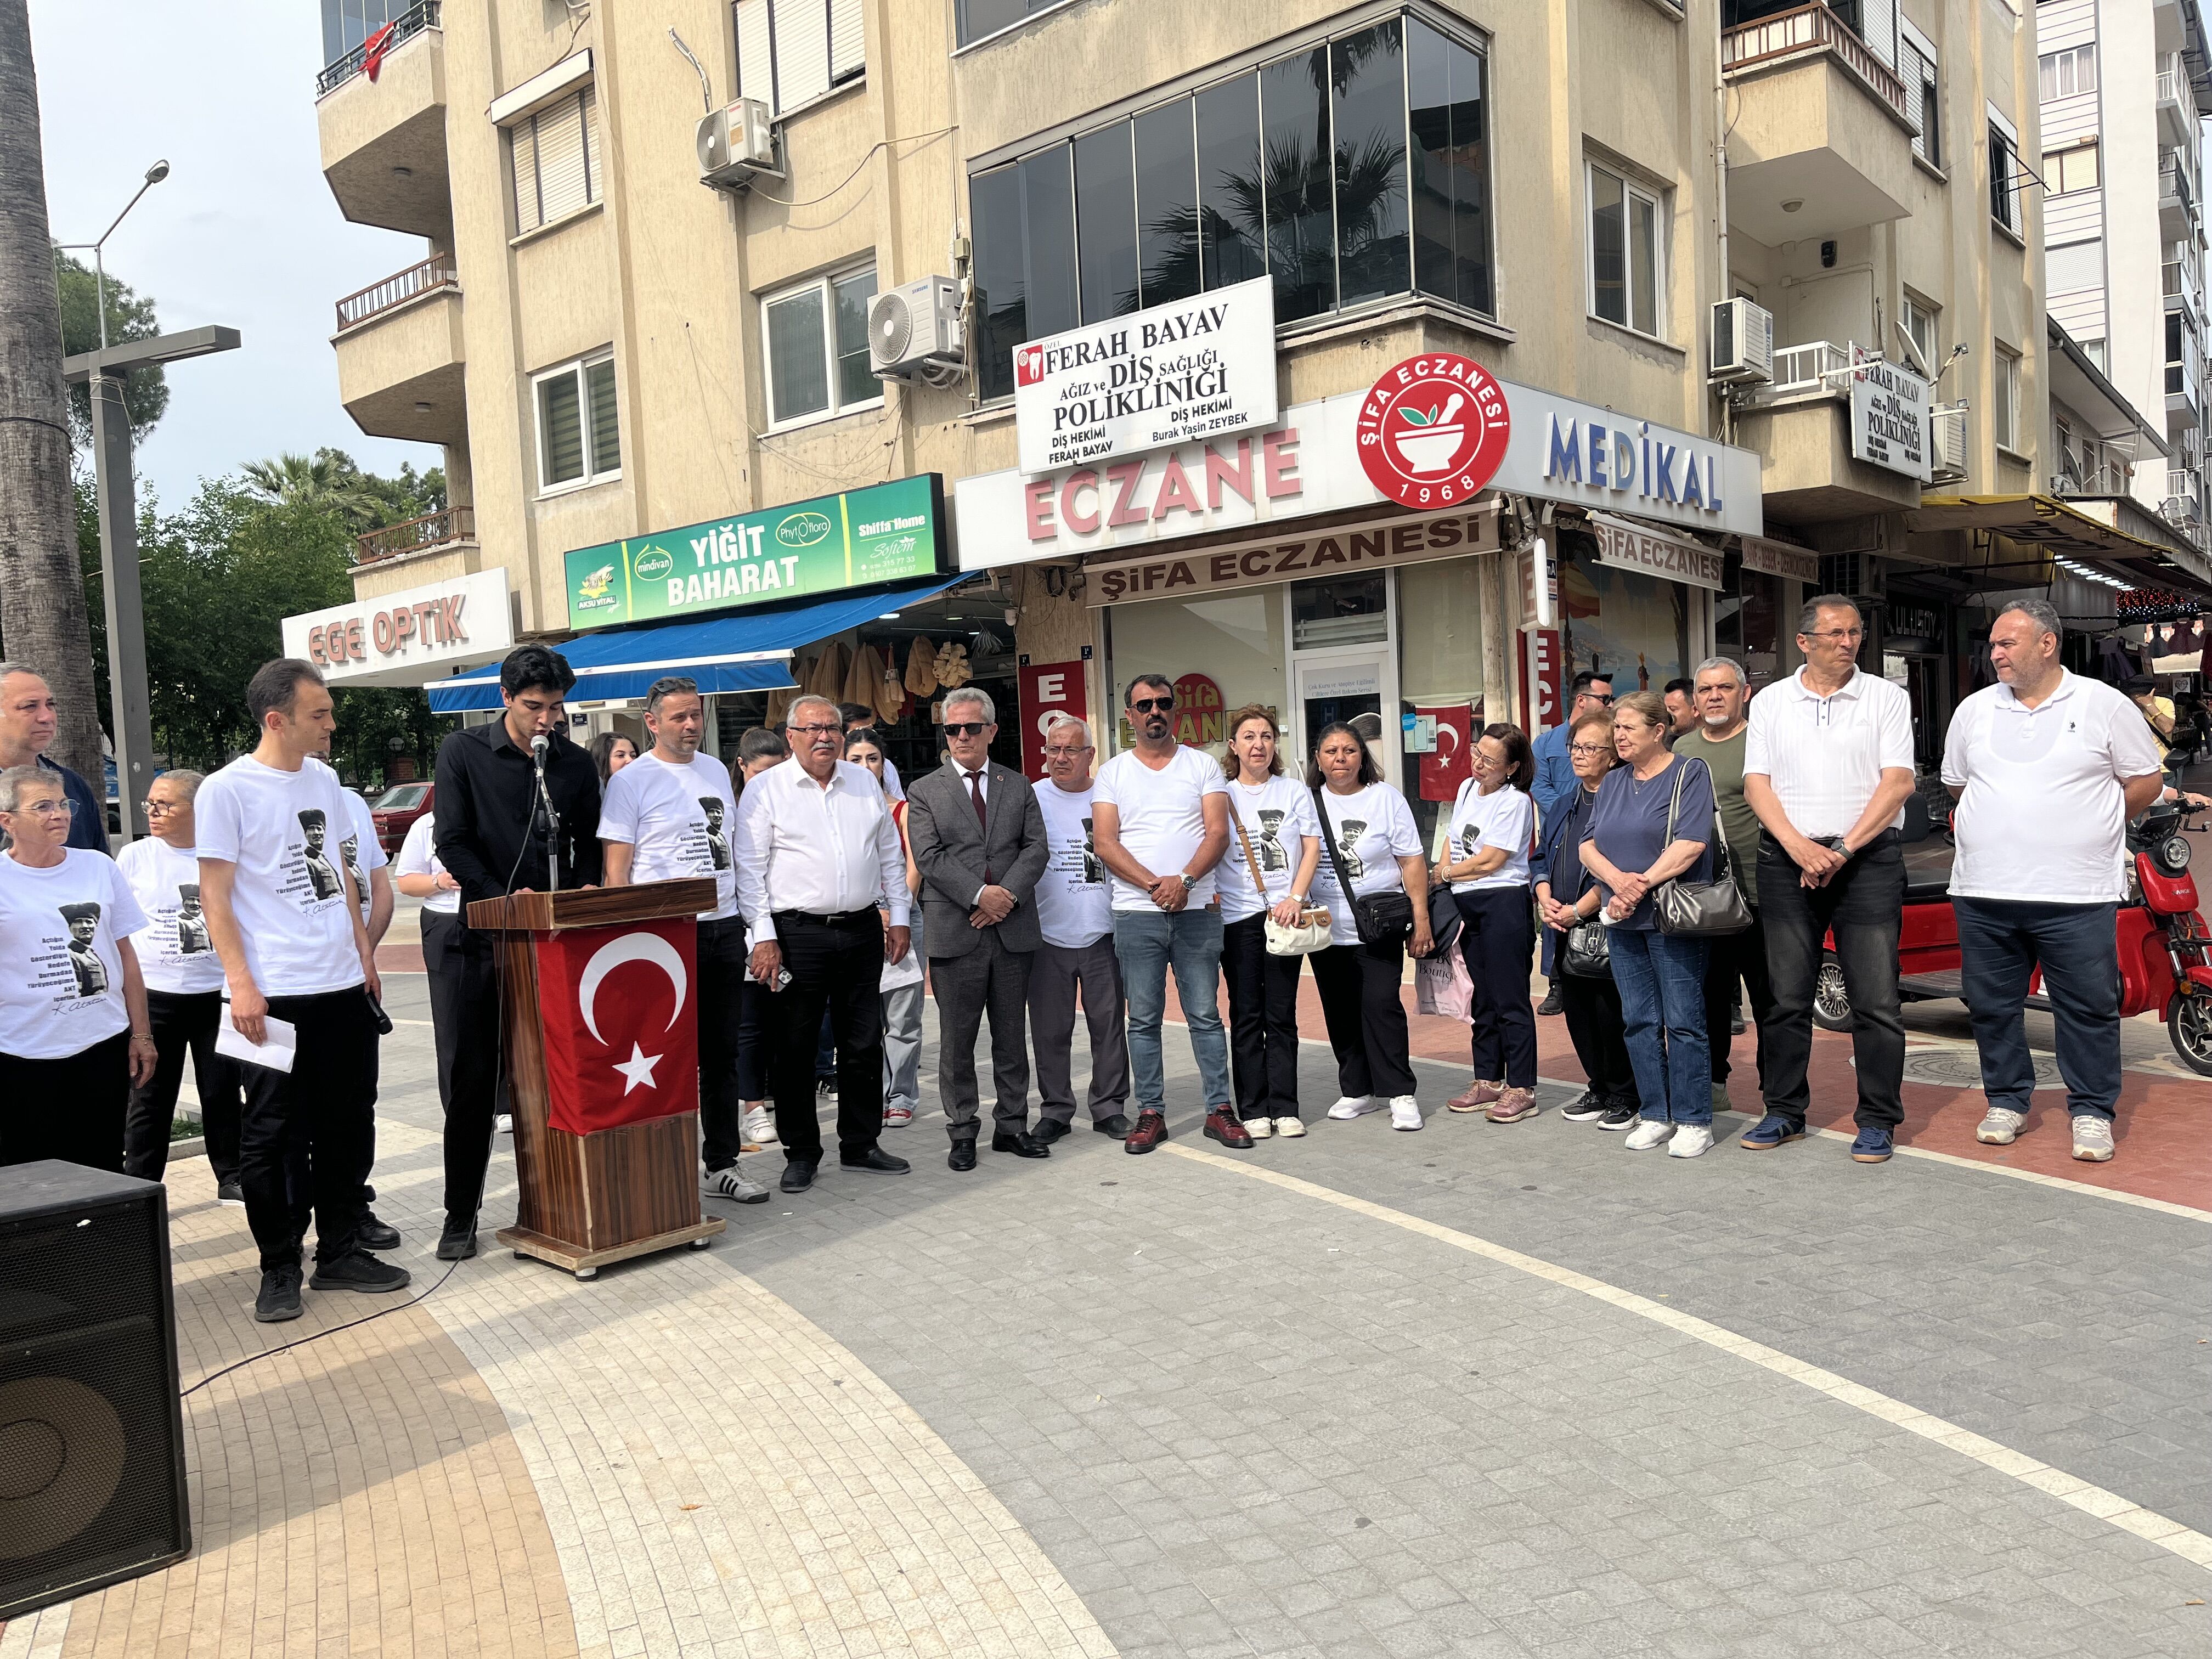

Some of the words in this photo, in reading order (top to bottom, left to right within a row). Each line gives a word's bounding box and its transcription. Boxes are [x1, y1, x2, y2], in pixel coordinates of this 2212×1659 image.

[1045, 330, 1130, 375] FERAH
[1140, 303, 1229, 349] BAYAV
[1045, 341, 1062, 350] ÖZEL
[1060, 382, 1091, 401] AĞIZ
[1094, 381, 1106, 391] ve
[1109, 353, 1153, 388] DİŞ
[1159, 348, 1218, 376] SAĞLIĞI
[1895, 375, 1920, 403] BAYAV
[1053, 362, 1228, 431] POLİKLİNİĞİ
[1171, 407, 1189, 422] DİŞ
[1192, 396, 1233, 418] HEKİMİ
[1359, 388, 1391, 445] ŞİFA
[1396, 359, 1508, 428] ECZANESİ
[1887, 393, 1900, 423] DİŞ
[1052, 435, 1068, 449] DİŞ
[1070, 424, 1107, 444] HEKİMİ
[1153, 430, 1179, 442] Burak
[1181, 421, 1206, 436] Yasin
[1209, 412, 1248, 430] ZEYBEK
[1049, 448, 1079, 465] FERAH
[1083, 441, 1113, 458] BAYAV
[1544, 411, 1722, 512] MEDİKAL
[1024, 427, 1303, 541] ECZANE
[1399, 475, 1475, 503] 1968
[859, 520, 891, 537] Shiffa
[894, 515, 926, 531] Home
[690, 523, 765, 567] YİĞİT
[637, 558, 669, 573] mindivan
[667, 555, 799, 607] BAHARAT
[308, 618, 364, 664] EGE
